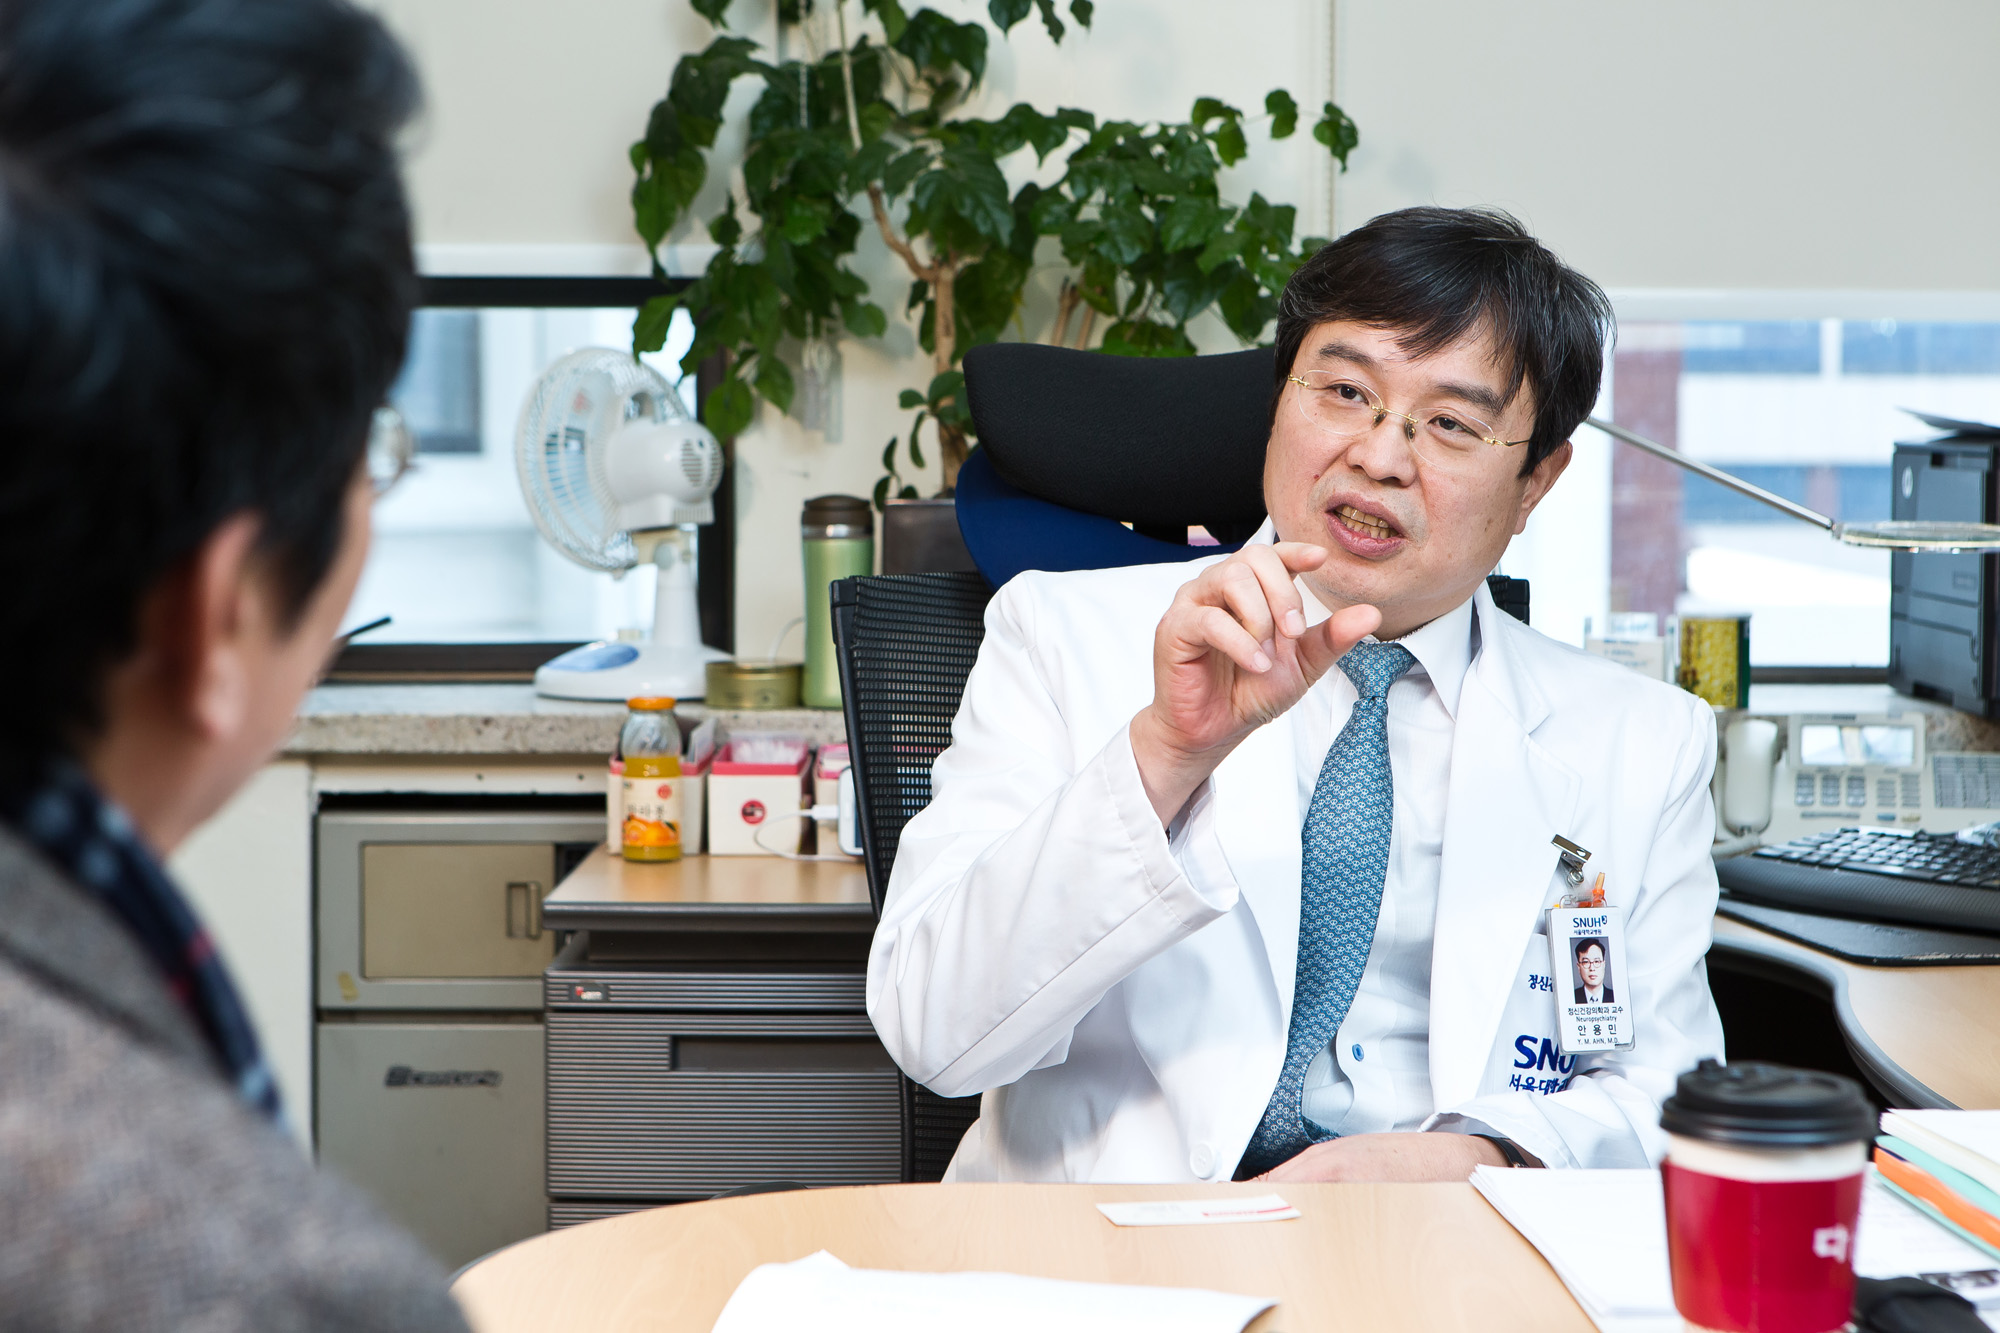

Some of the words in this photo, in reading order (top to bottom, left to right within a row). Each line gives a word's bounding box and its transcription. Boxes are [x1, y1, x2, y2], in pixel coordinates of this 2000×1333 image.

[1572, 917, 1601, 928] SNUH
[1568, 1006, 1609, 1016] 정신건강의학과
[1611, 1006, 1624, 1014] 교수
